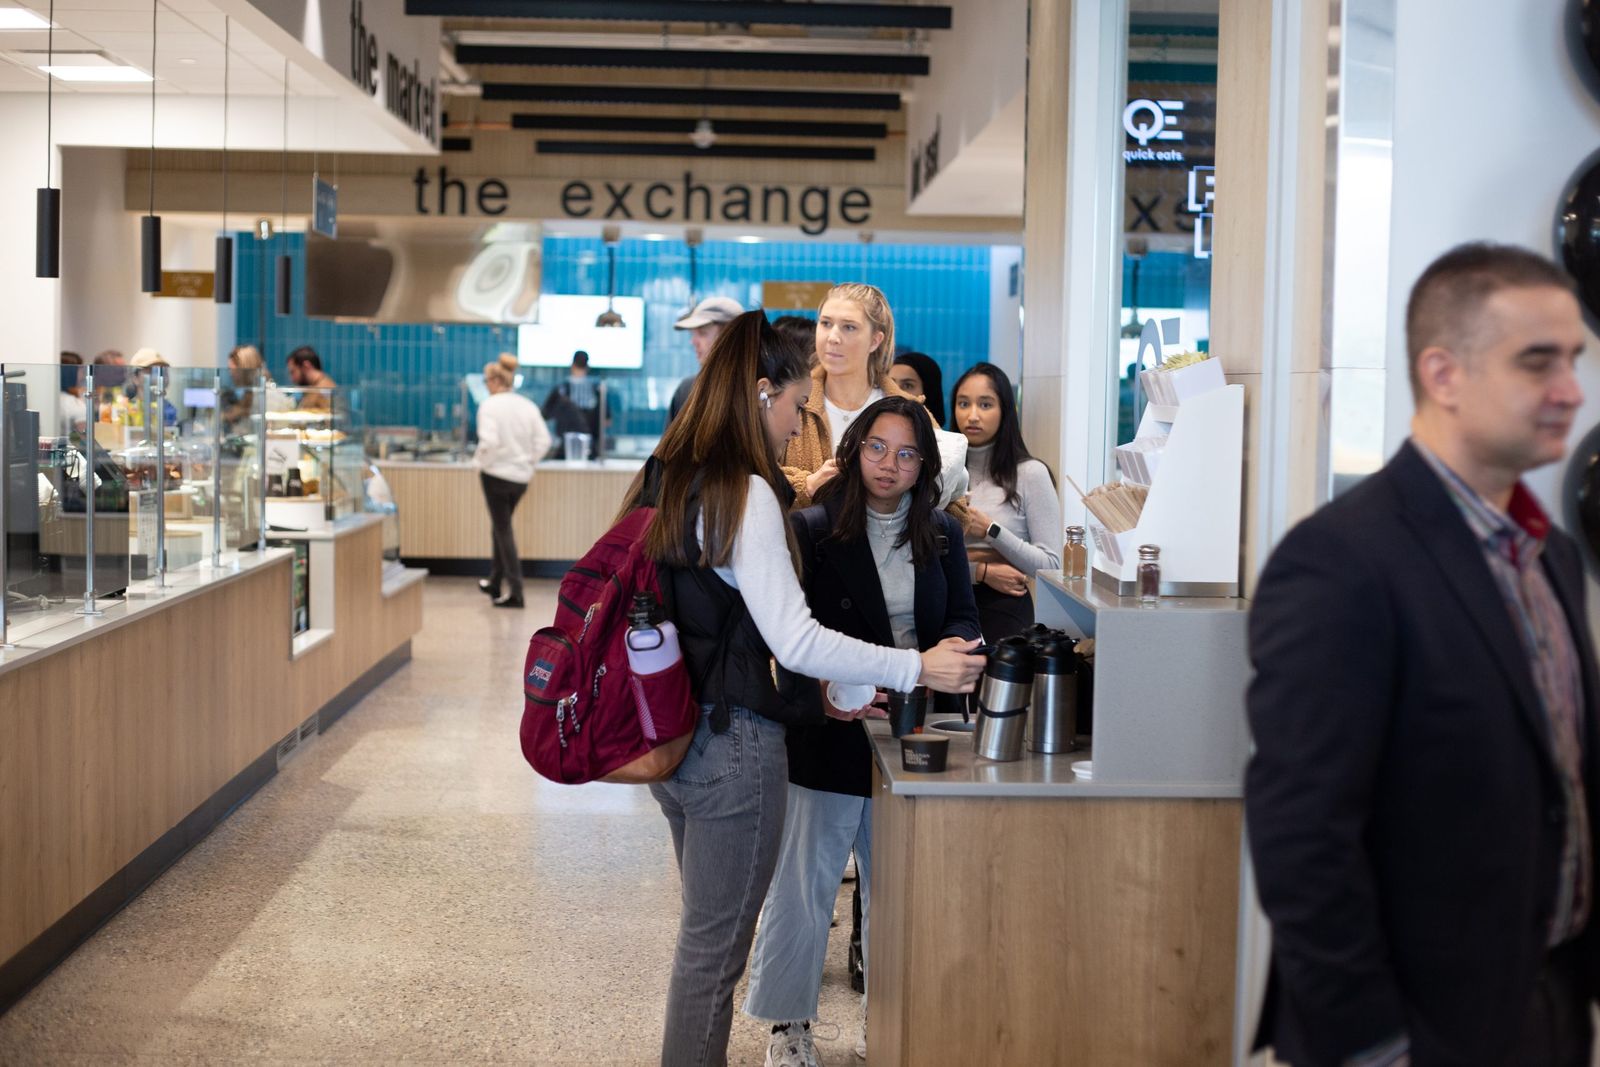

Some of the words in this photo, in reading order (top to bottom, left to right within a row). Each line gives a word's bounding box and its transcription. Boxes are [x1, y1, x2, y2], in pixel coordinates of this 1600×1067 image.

[350, 0, 378, 97] the
[386, 51, 437, 144] market
[1123, 99, 1184, 145] QE
[1122, 148, 1155, 162] quick
[413, 166, 510, 215] the
[560, 171, 872, 236] exchange
